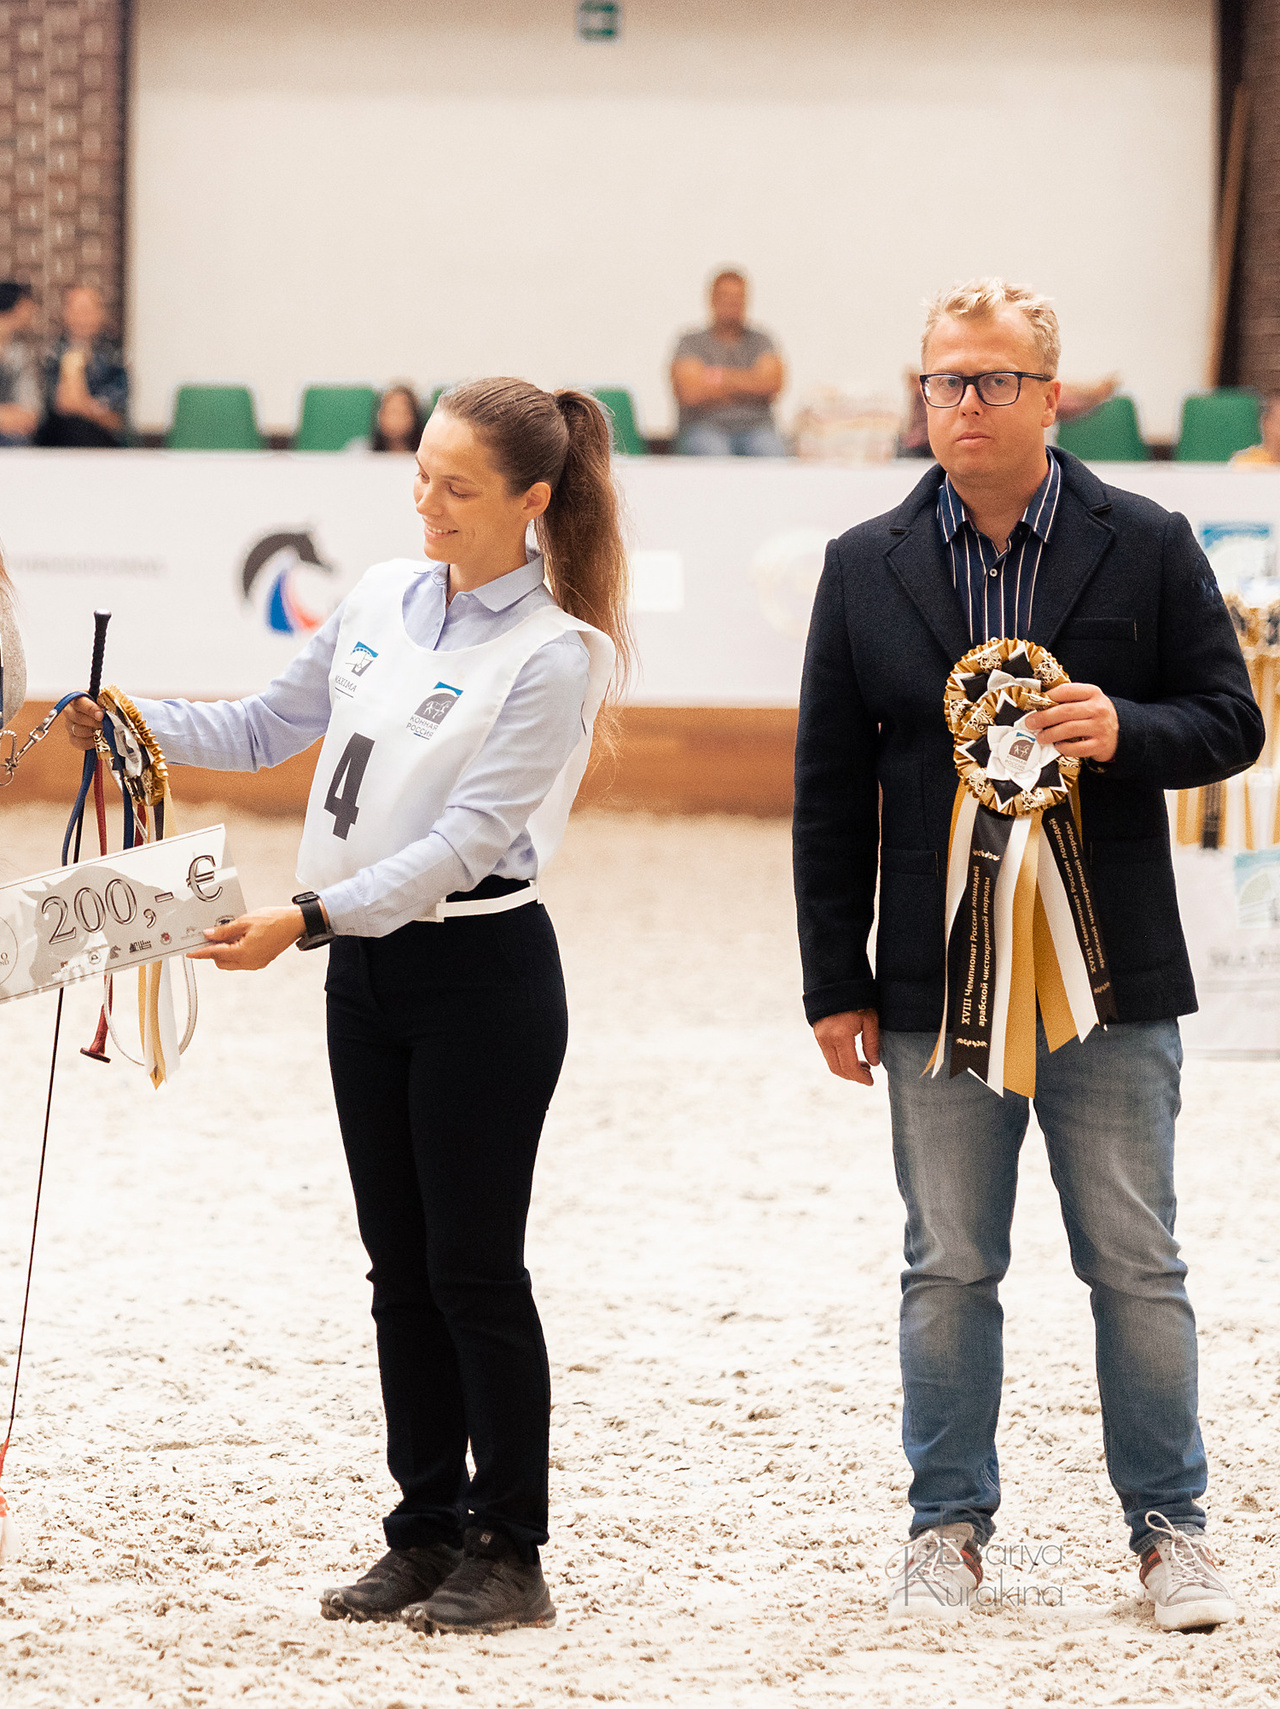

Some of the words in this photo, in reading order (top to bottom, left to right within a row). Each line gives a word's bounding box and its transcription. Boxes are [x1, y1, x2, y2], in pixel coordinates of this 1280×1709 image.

[406, 722, 434, 738] РОССИЯ
[409, 715, 439, 731] КОННАЯ
[323, 731, 376, 841] 4
[1048, 817, 1068, 860] лошадей
[972, 866, 980, 909] лошадей
[983, 876, 991, 914] породы
[1064, 860, 1077, 895] России
[1074, 859, 1095, 925] чистокровной
[970, 909, 979, 942] России
[1074, 895, 1090, 947] Чемпионат
[964, 943, 978, 994] Чемпионат
[982, 914, 991, 981] чистокровной
[1090, 926, 1106, 969] арабской
[961, 998, 972, 1026] XVIII
[978, 982, 989, 1027] арабской
